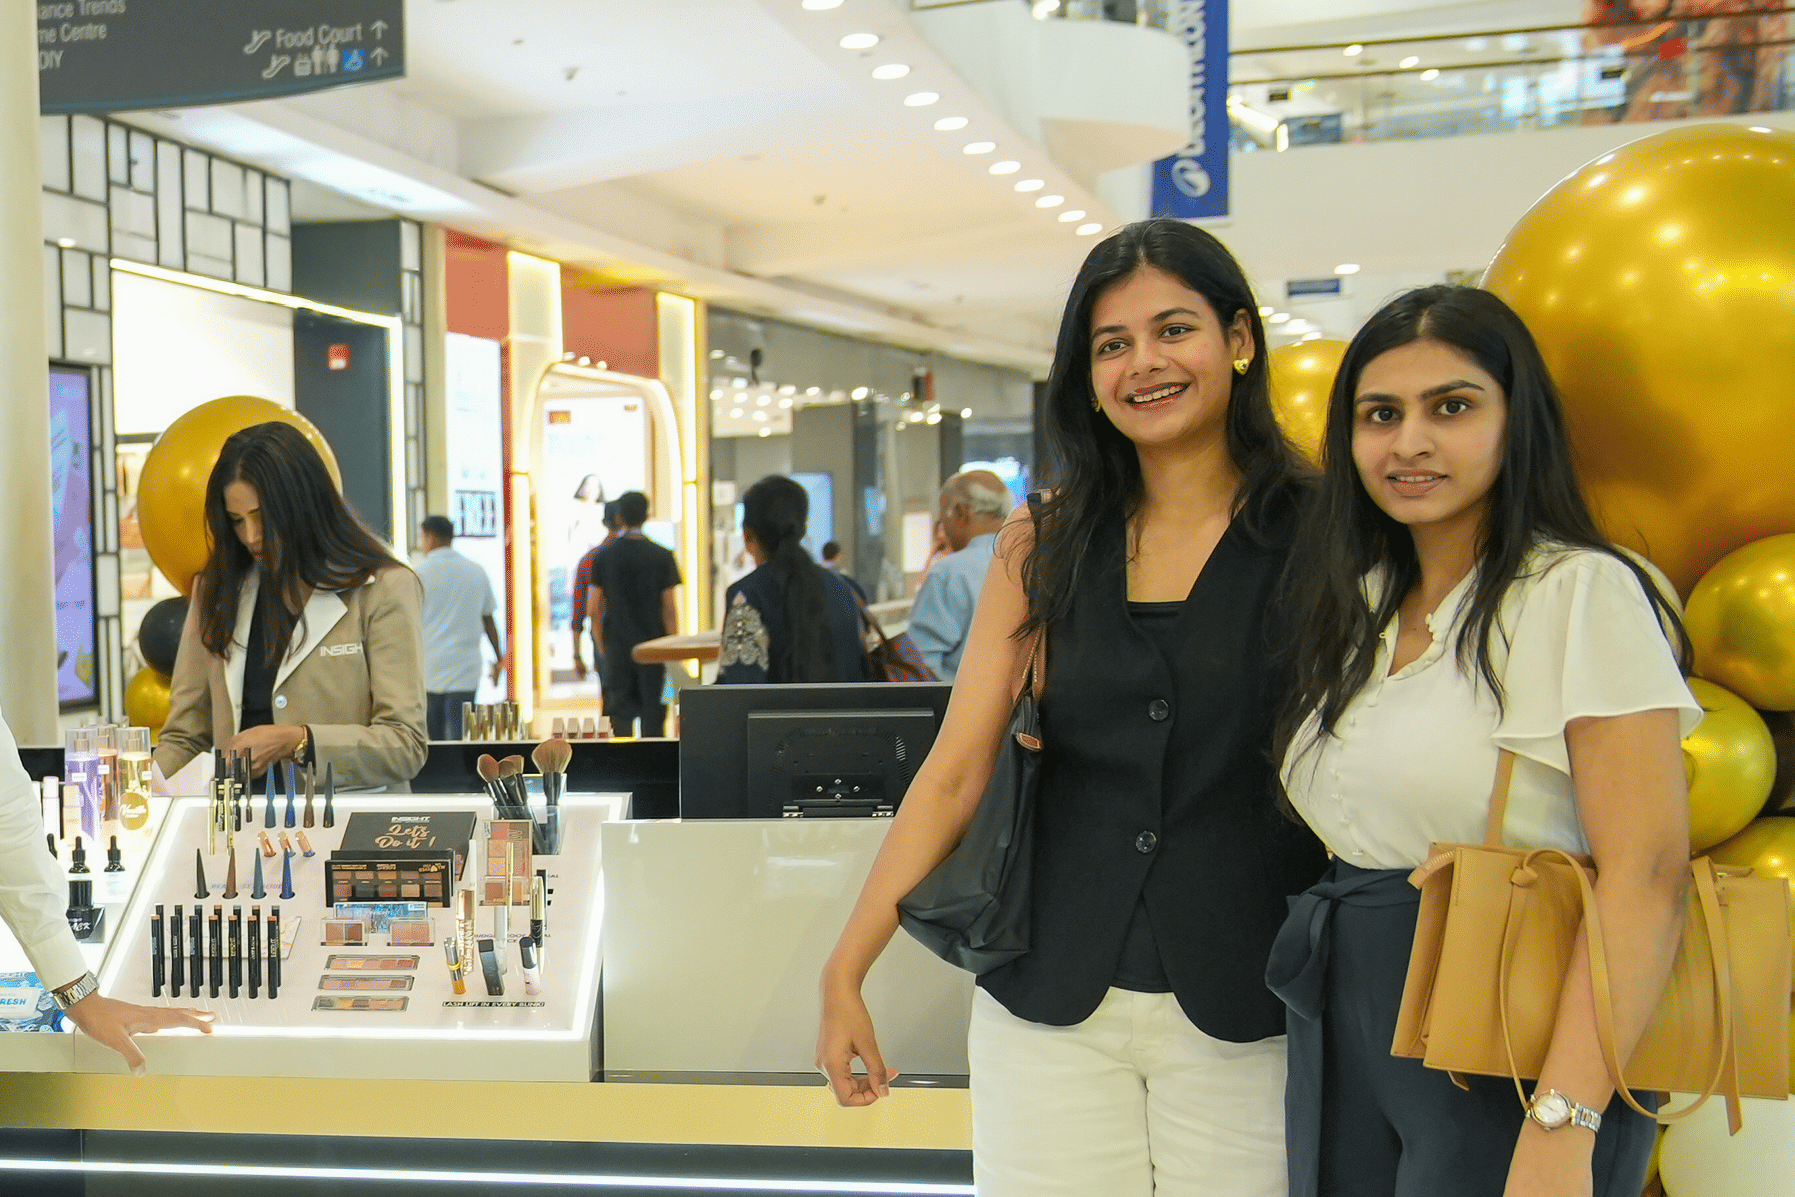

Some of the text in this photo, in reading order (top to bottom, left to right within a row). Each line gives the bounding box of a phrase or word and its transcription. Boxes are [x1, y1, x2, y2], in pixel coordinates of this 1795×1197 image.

[276, 23, 363, 48] Food Court
[320, 641, 363, 657] INSIGH
[375, 835, 403, 848] Do
